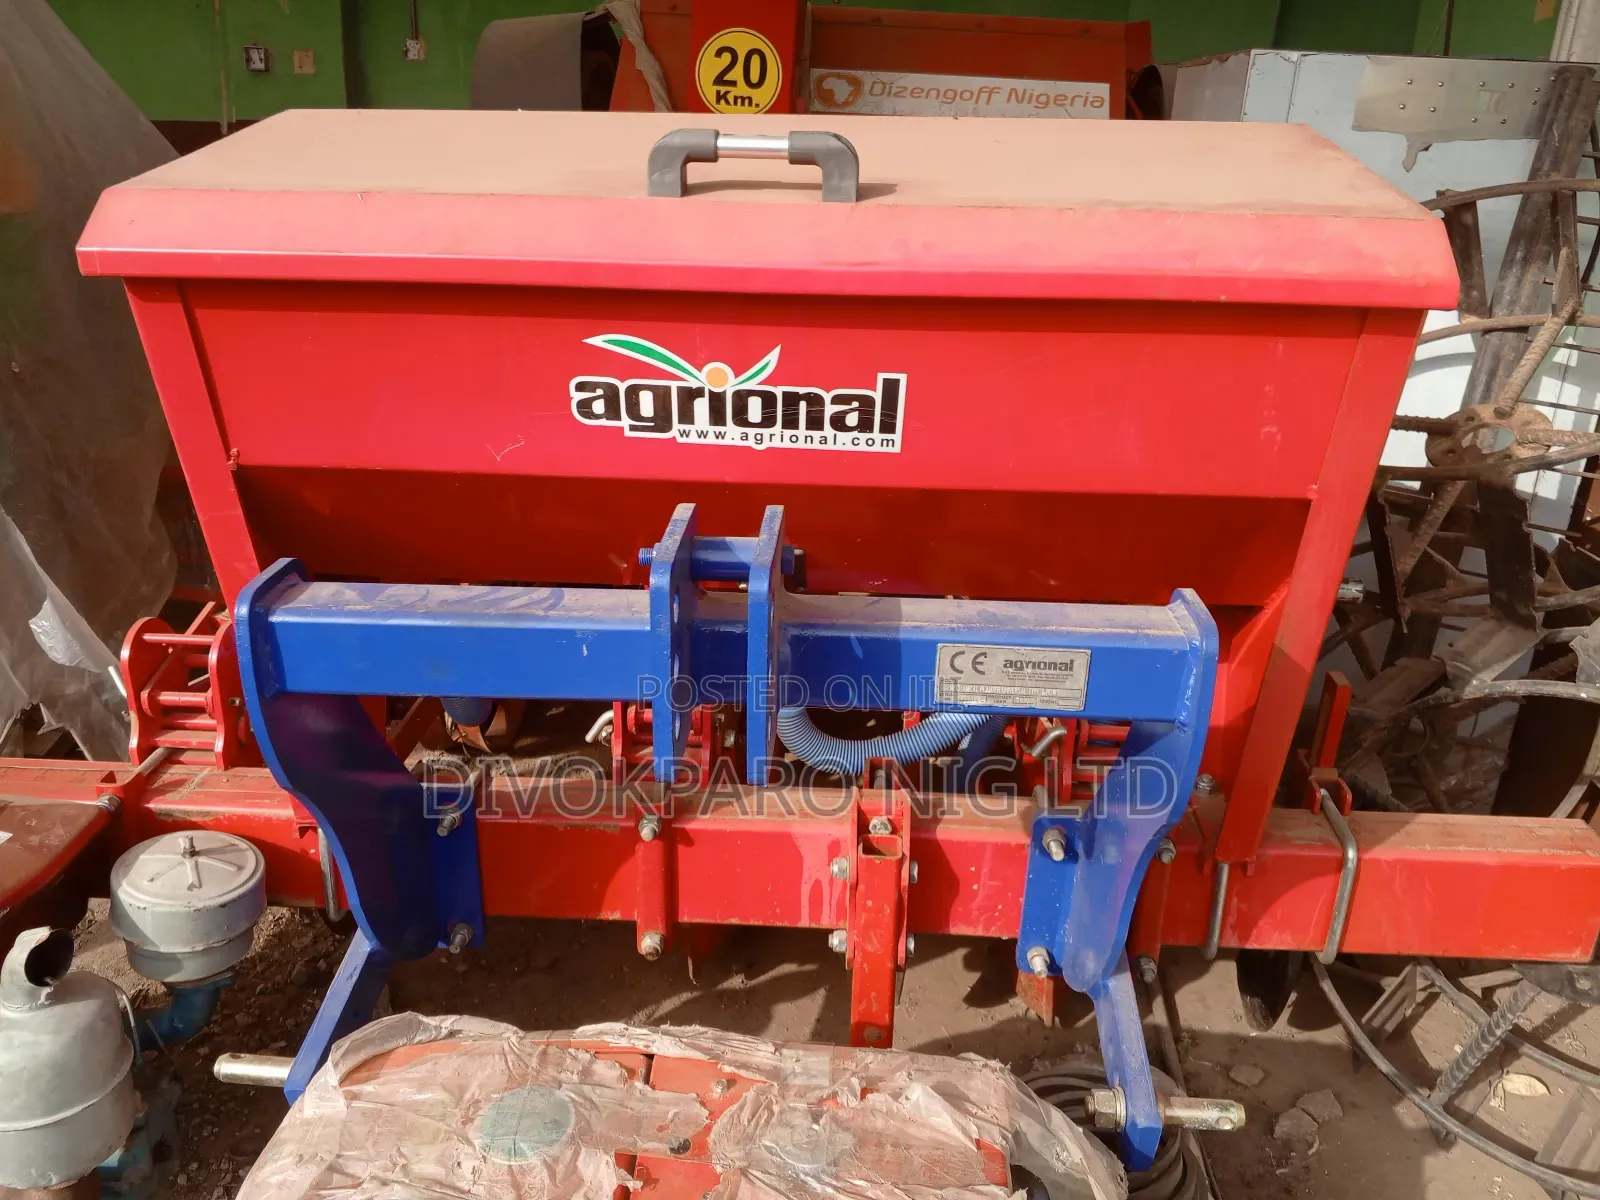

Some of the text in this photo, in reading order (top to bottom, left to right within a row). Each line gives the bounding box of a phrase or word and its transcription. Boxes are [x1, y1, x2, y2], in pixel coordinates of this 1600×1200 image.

[712, 45, 768, 89] 20
[714, 90, 760, 109] Km.
[867, 79, 1106, 110] Dizengoff Nigeria
[573, 377, 901, 434] agrional
[677, 427, 896, 449] www.agrional.com
[949, 651, 988, 676] CE
[1003, 658, 1075, 672] agrional
